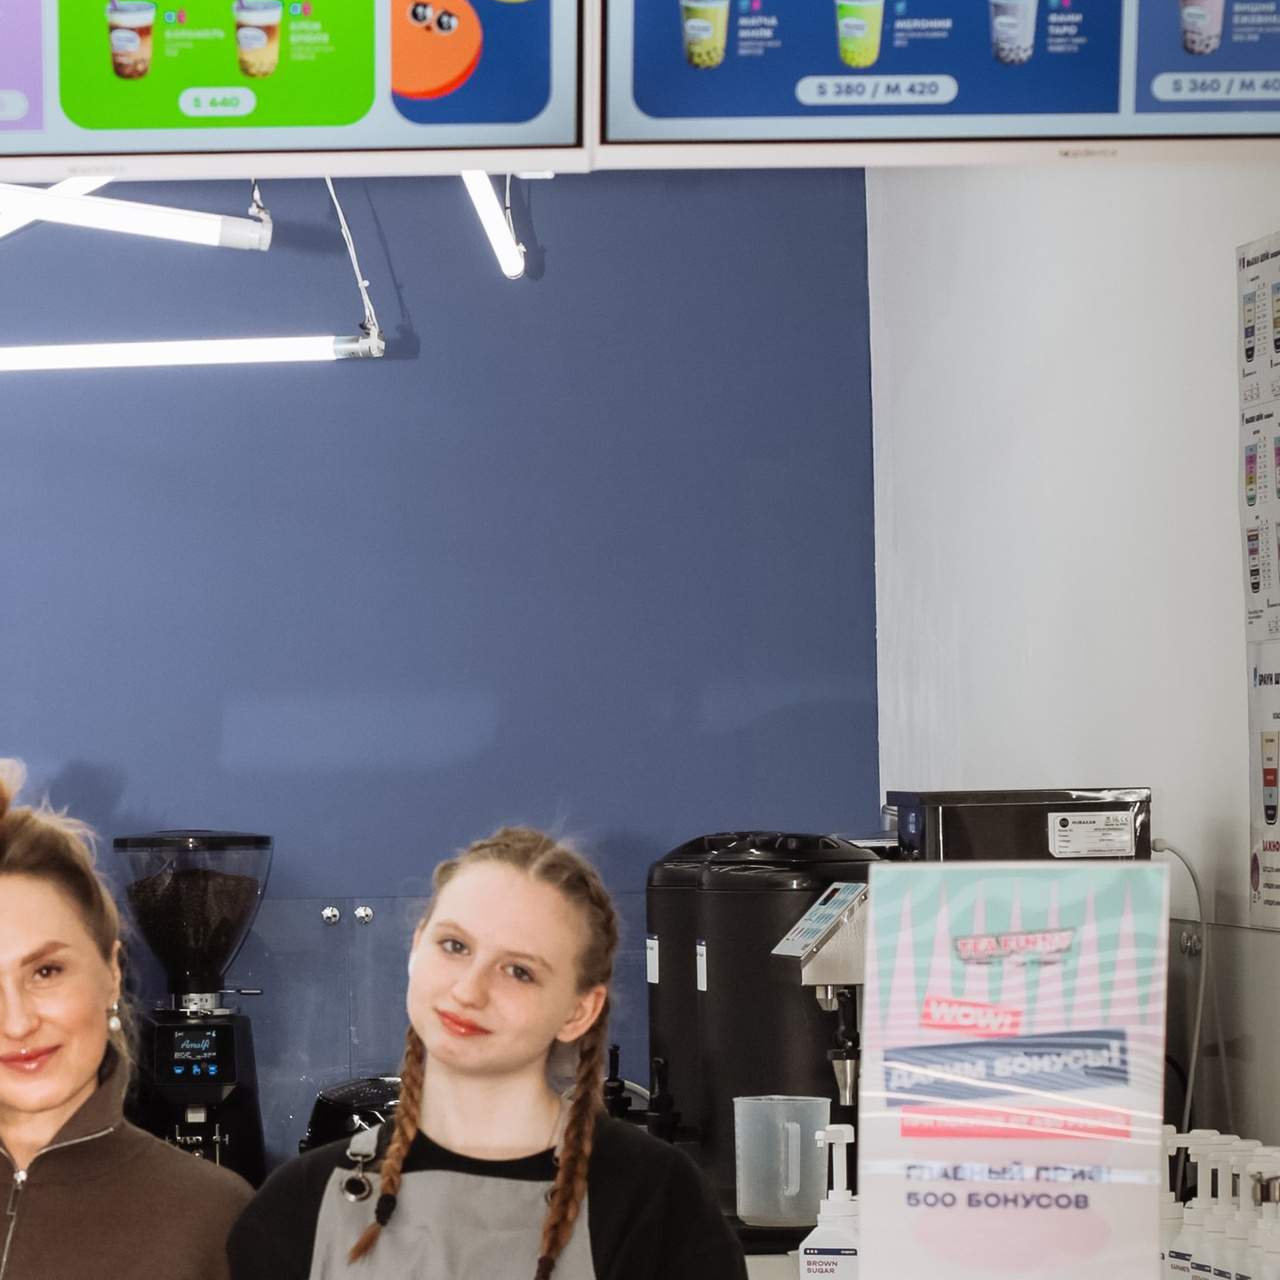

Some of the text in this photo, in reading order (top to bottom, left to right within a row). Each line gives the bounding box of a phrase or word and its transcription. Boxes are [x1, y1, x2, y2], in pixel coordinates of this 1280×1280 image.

[817, 84, 827, 97] S
[885, 83, 901, 95] M
[906, 82, 939, 95] 420
[1172, 79, 1182, 92] S
[1239, 78, 1256, 91] M
[907, 1192, 1090, 1209] 500 БОНУСОВ
